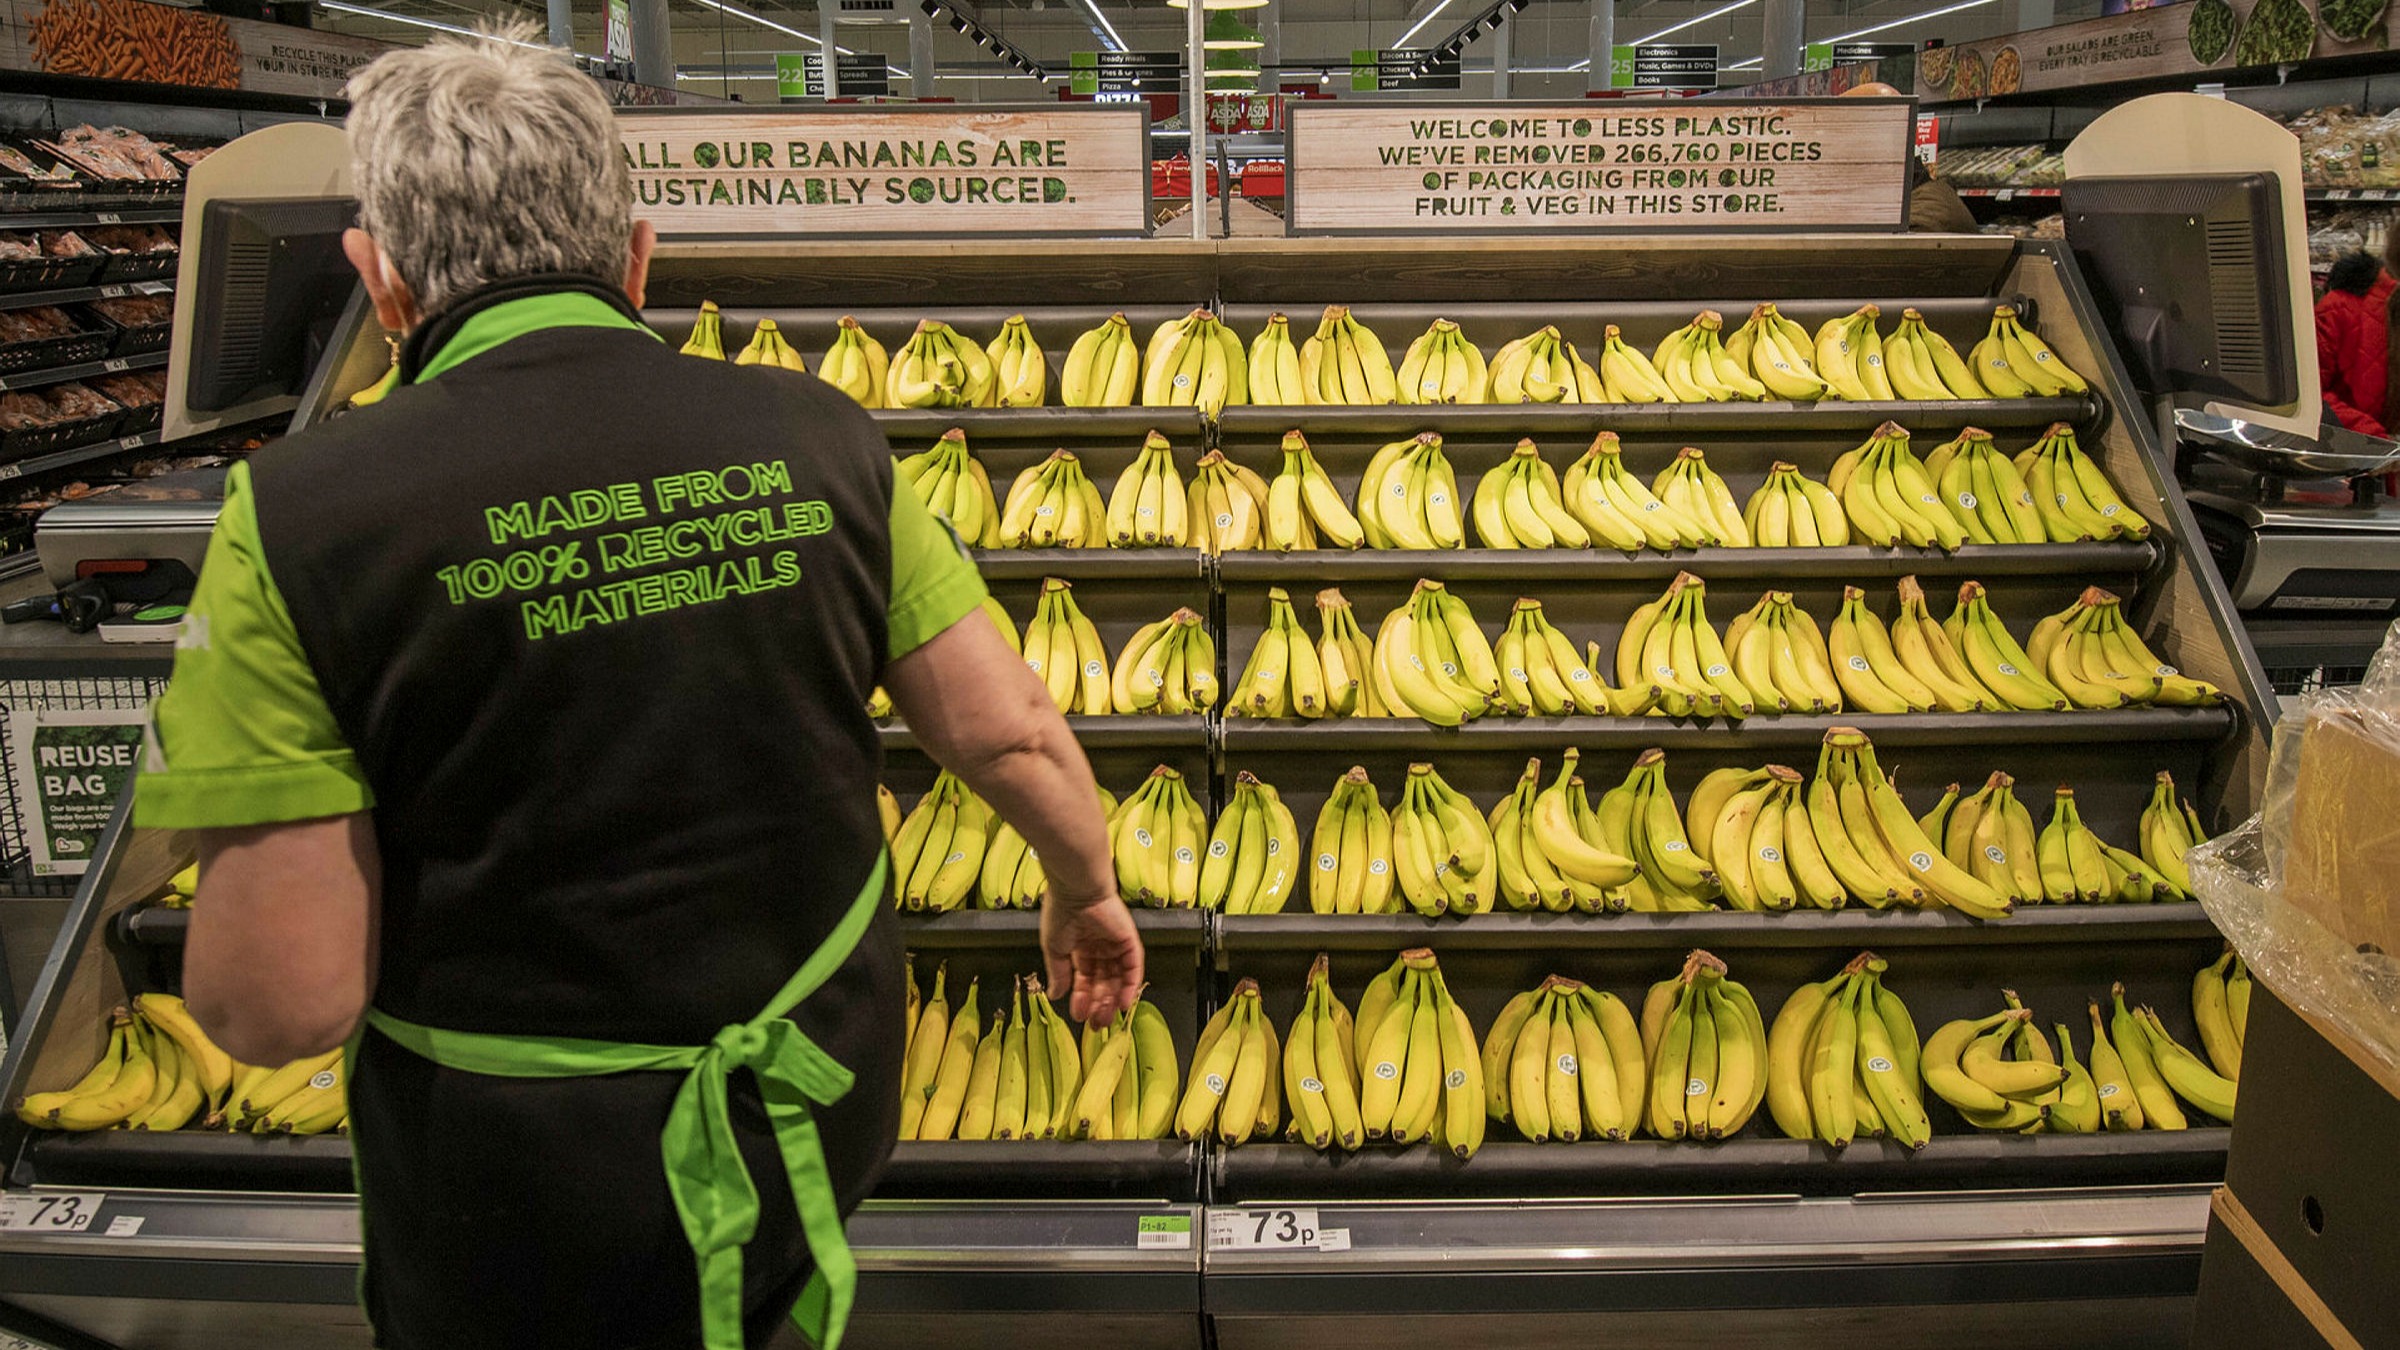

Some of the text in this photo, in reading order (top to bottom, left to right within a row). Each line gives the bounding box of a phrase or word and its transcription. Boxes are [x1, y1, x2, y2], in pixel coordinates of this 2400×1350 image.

[2101, 35, 2119, 48] ARE
[271, 45, 315, 62] RECYCLE
[317, 51, 338, 65] THIS
[1101, 55, 1124, 63] Ready
[1381, 51, 1404, 59] Bacon
[1405, 51, 1411, 59] &
[1640, 48, 1678, 56] Electronics
[1836, 46, 1872, 55] Medicines
[256, 58, 285, 73] YOUR
[288, 63, 298, 74] IN
[300, 64, 330, 79] STORE
[1611, 60, 1632, 74] 25
[1808, 58, 1830, 72] 26
[2039, 54, 2065, 72] EVERY
[2067, 50, 2089, 68] TRAY
[2090, 52, 2099, 64] IS
[780, 68, 802, 83] 22
[839, 71, 869, 79] Spreads
[1101, 69, 1117, 77] Pies
[1118, 69, 1123, 77] &
[1638, 76, 1660, 84] Books
[1210, 108, 1242, 119] ASDA
[1247, 105, 1270, 119] ASDA
[1410, 116, 1791, 139] WELCOME TO LESS PLASTIC.
[621, 139, 1067, 169] ALL OUR BANANAS ARE
[1475, 144, 1605, 164] REMOVED
[1614, 143, 1720, 166] 266,760
[1730, 141, 1822, 162] PIECES
[1422, 167, 1776, 190] OF PACKAGING FROM OUR
[884, 176, 1076, 204] SOURCED.
[1415, 193, 1784, 216] FRUIT & VEG IN THIS STORE.
[485, 460, 793, 544] MADE FROM
[436, 500, 834, 605] 100% RECYCLED
[521, 550, 802, 640] MATERIALS
[39, 745, 132, 768] REUSE
[43, 774, 106, 797] BAG
[52, 822, 79, 831] Weigh
[80, 823, 98, 831] your
